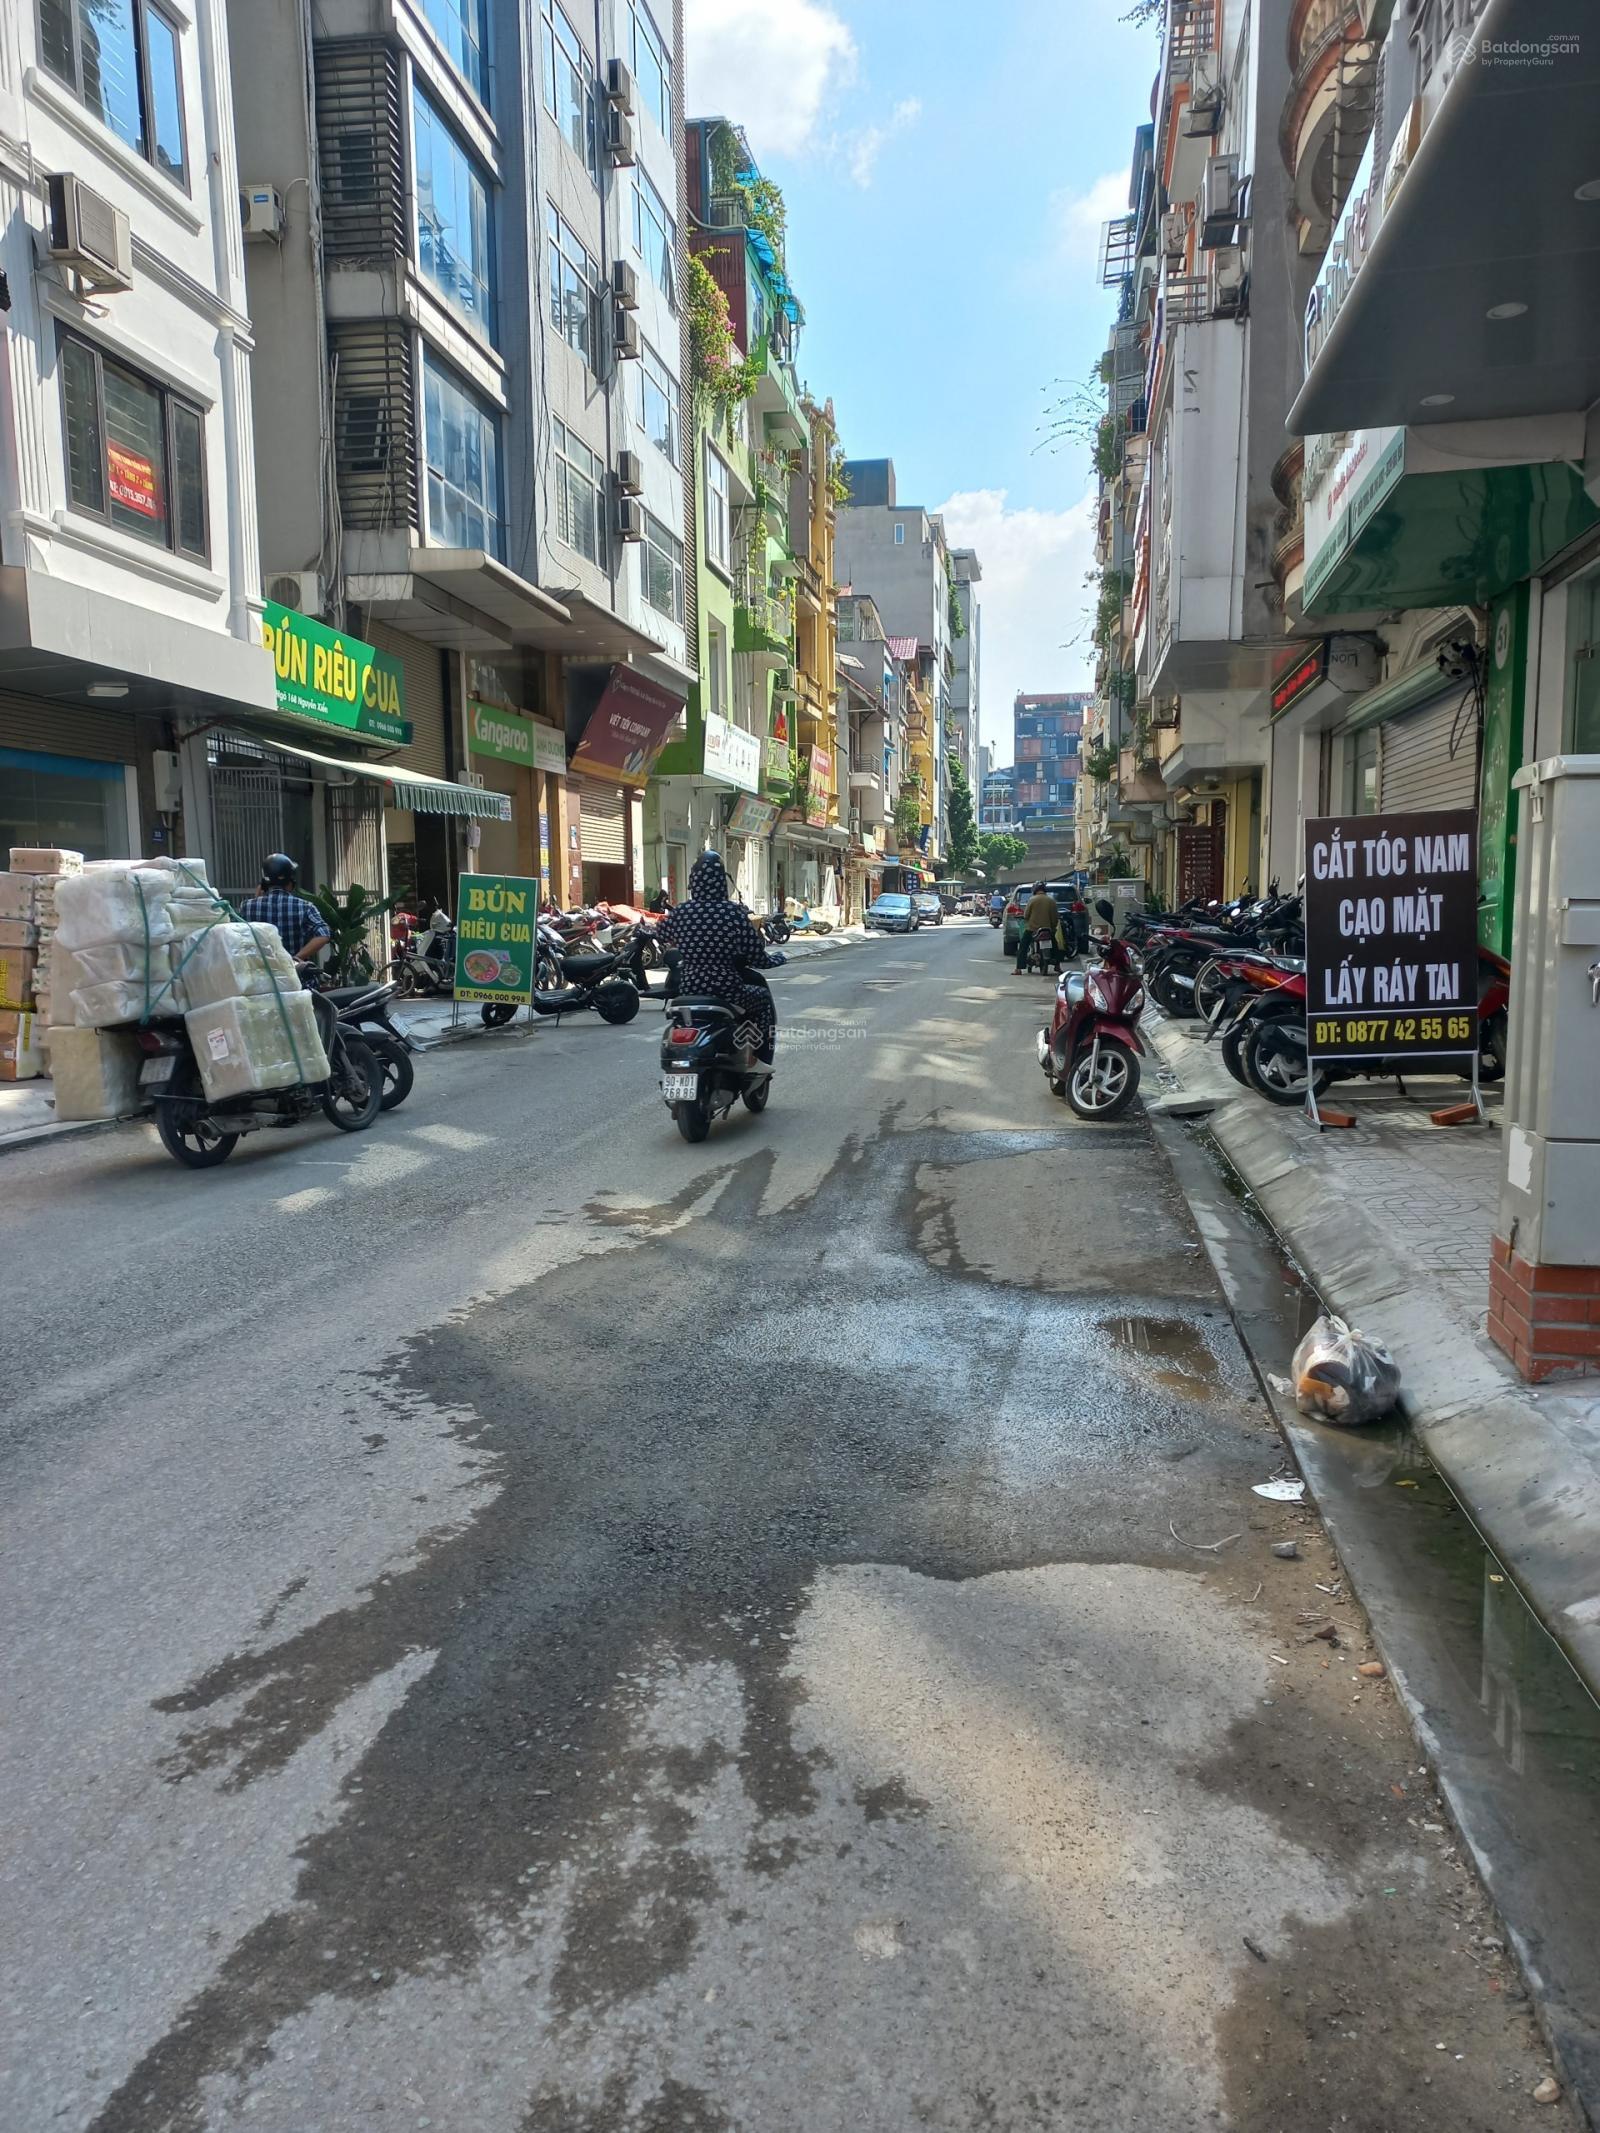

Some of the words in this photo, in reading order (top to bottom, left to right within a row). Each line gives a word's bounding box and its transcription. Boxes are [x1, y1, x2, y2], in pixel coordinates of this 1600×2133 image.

[313, 639, 357, 702] RIÊU
[361, 664, 401, 717] CUA
[469, 705, 529, 753] Kangaroo
[629, 721, 652, 738] COMPANY
[1312, 827, 1357, 880] CẮT
[1363, 831, 1407, 877] TÓC
[1414, 834, 1469, 874] NAM
[468, 883, 527, 914] BÚN
[1339, 897, 1386, 944] CẠO
[1393, 887, 1443, 941] MẶT
[460, 917, 496, 941] RIÊU
[500, 922, 531, 944] CUA
[473, 990, 493, 1001] 0966
[494, 992, 510, 1002] 000
[511, 994, 526, 1004] 998
[1325, 954, 1366, 1005] LẤY
[1373, 957, 1419, 1003] RÁY
[1426, 962, 1459, 1001] TAI
[1316, 1022, 1341, 1044] ĐT:
[1346, 1020, 1389, 1043] 0877
[1394, 1019, 1416, 1041] 42
[1420, 1017, 1442, 1040] 55
[1447, 1016, 1470, 1039] 65
